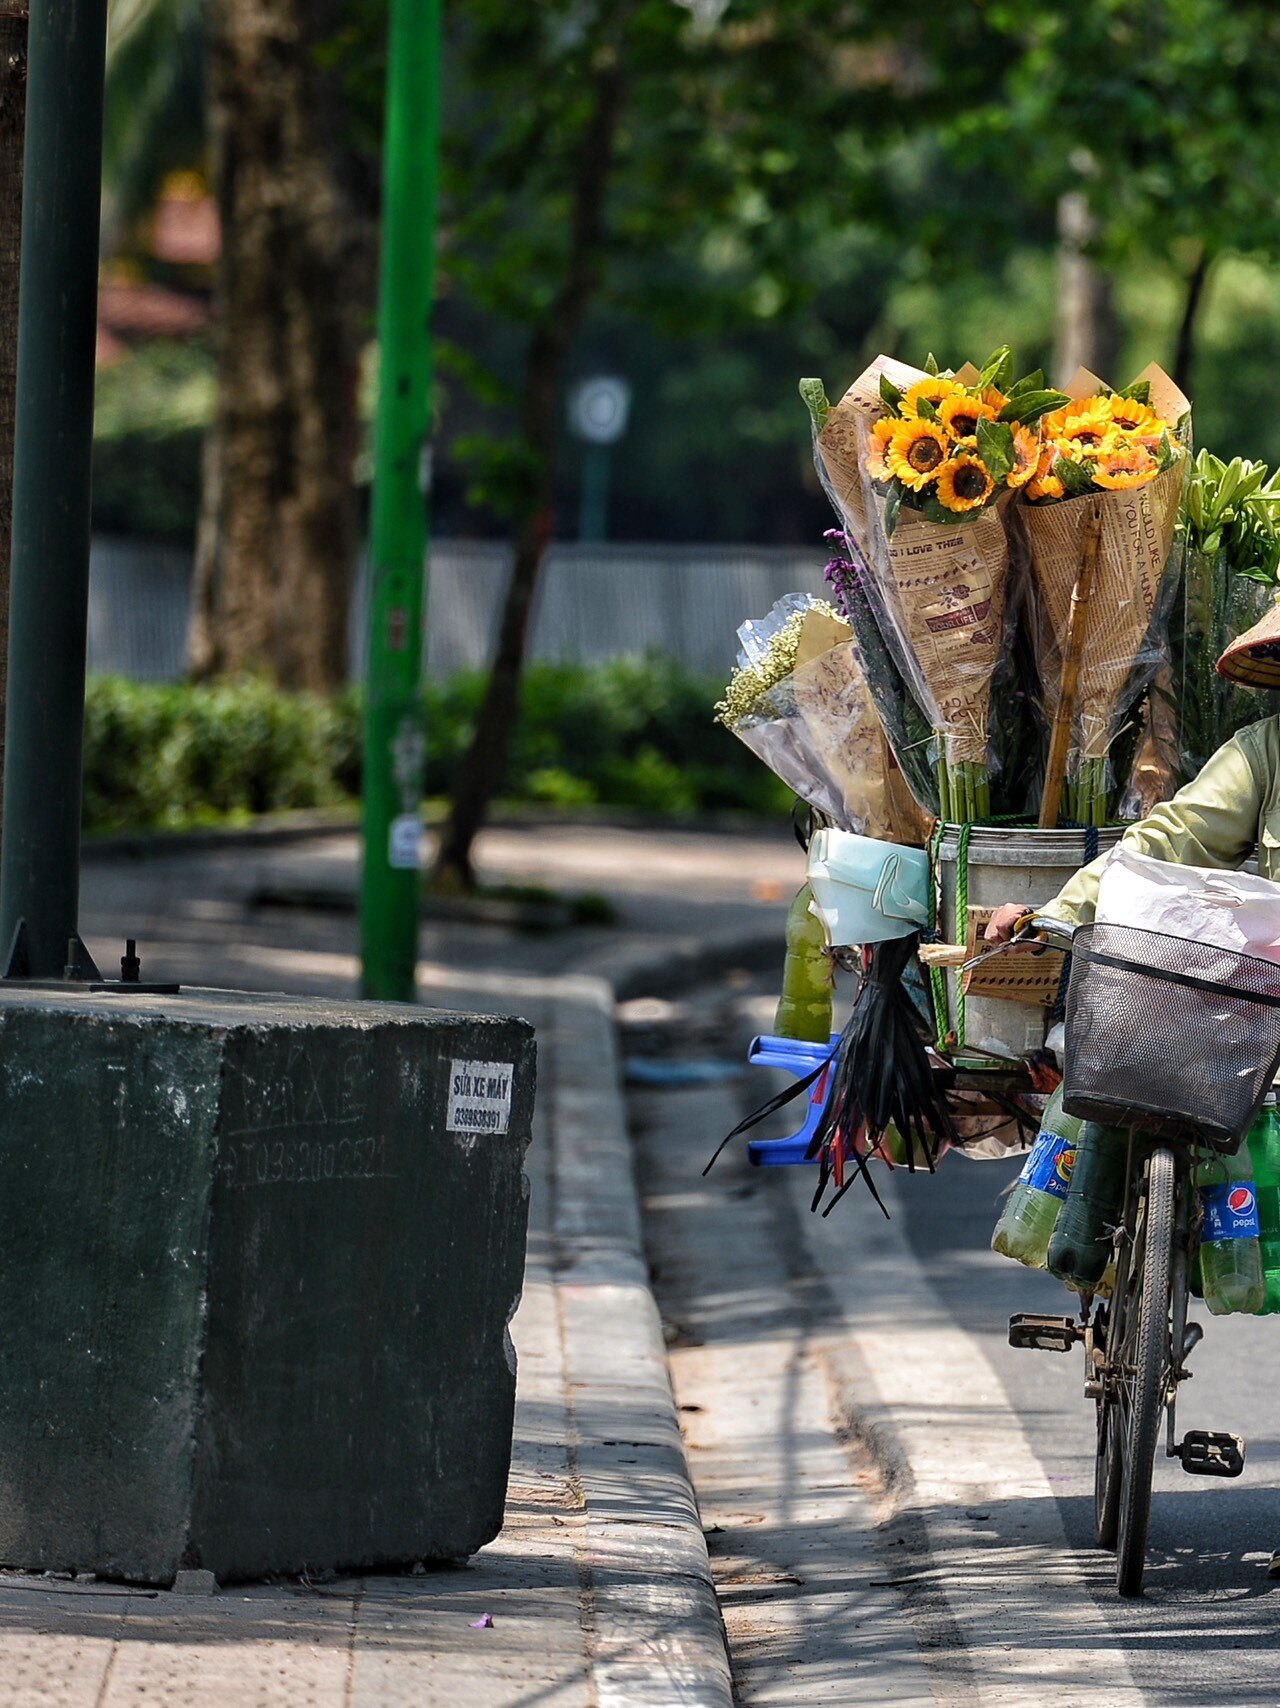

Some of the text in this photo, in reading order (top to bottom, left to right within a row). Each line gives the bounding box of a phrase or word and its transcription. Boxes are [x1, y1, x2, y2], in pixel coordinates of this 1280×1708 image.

[1124, 501, 1137, 530] YOU
[907, 544, 932, 556] LOVE
[936, 537, 964, 549] THEE
[1130, 531, 1144, 557] FOR
[1147, 541, 1161, 568] LIKE
[1137, 561, 1145, 571] A
[956, 614, 975, 626] LIFE
[454, 1064, 508, 1099] SỬA XE MÁY
[1233, 1217, 1255, 1228] pepsi
